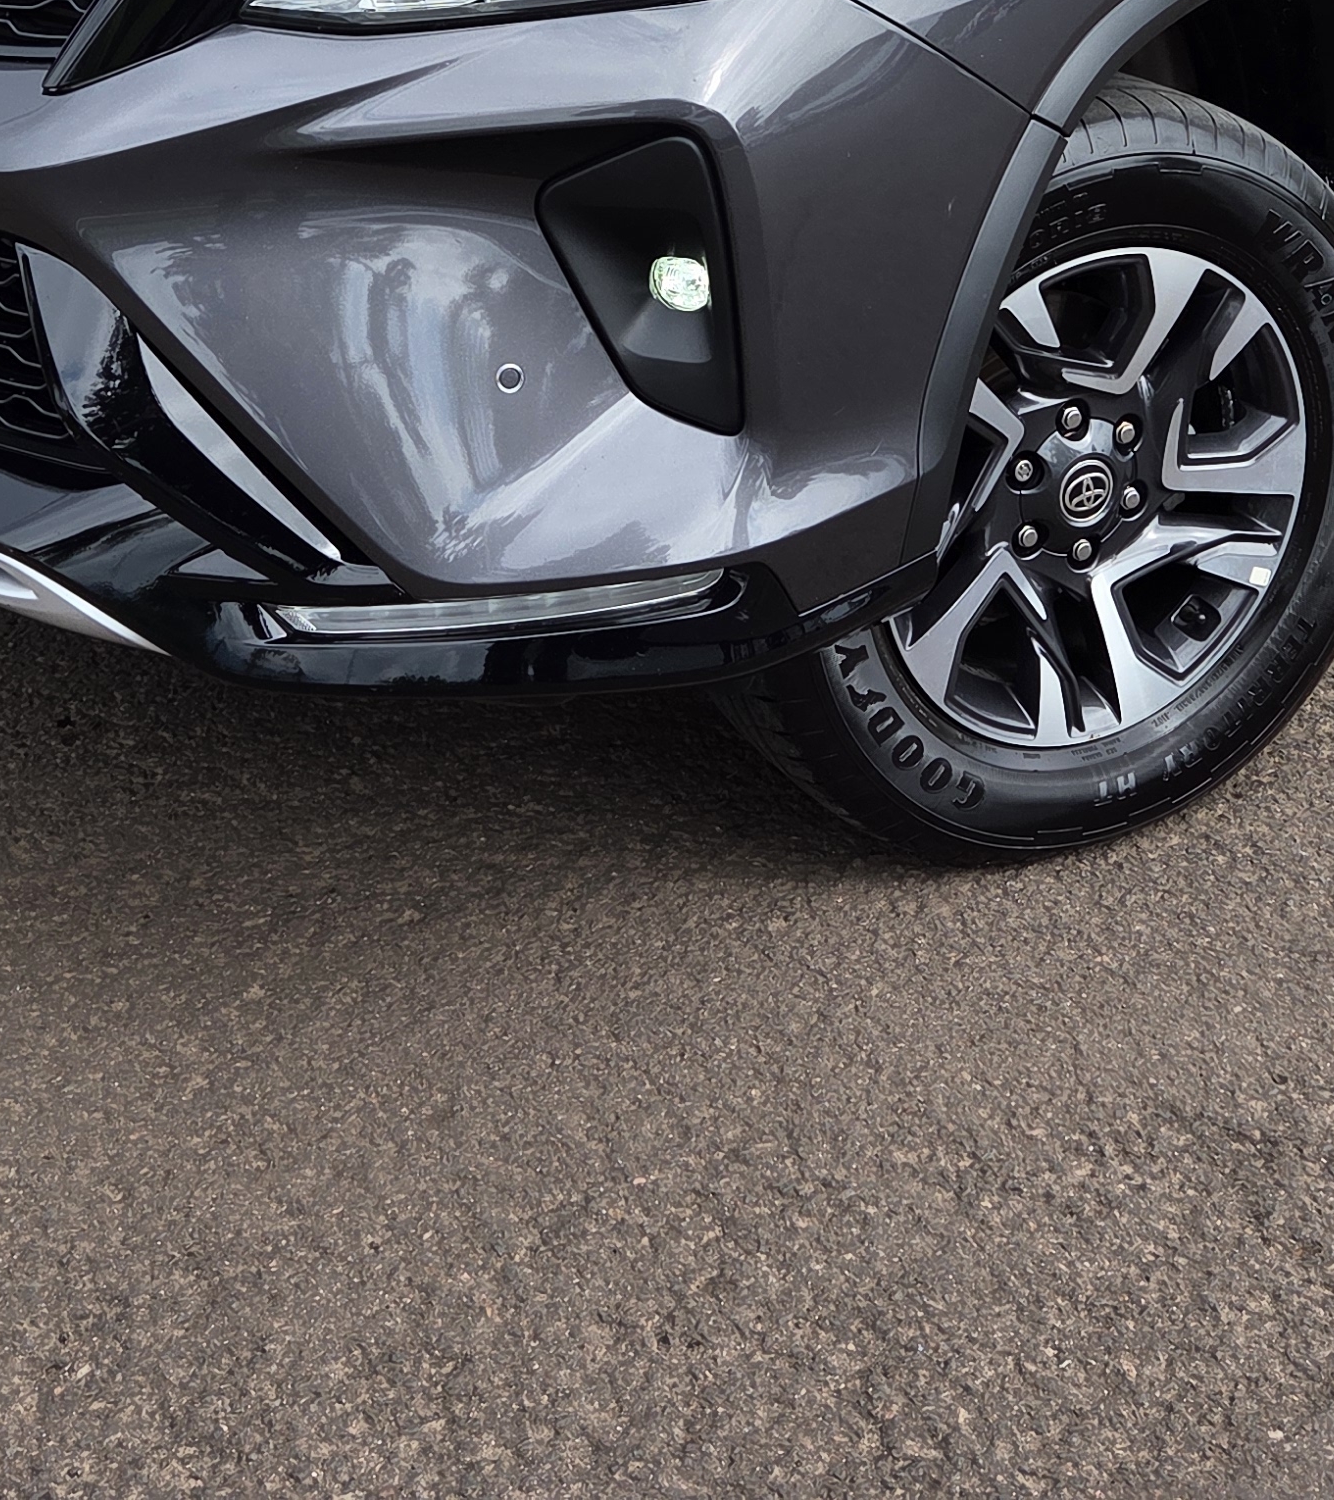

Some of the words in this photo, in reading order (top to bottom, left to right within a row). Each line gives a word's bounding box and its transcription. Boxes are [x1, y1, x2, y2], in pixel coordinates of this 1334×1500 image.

[833, 643, 986, 812] GOODY
[1163, 616, 1317, 781] TERRITORY
[1094, 771, 1138, 807] HT
